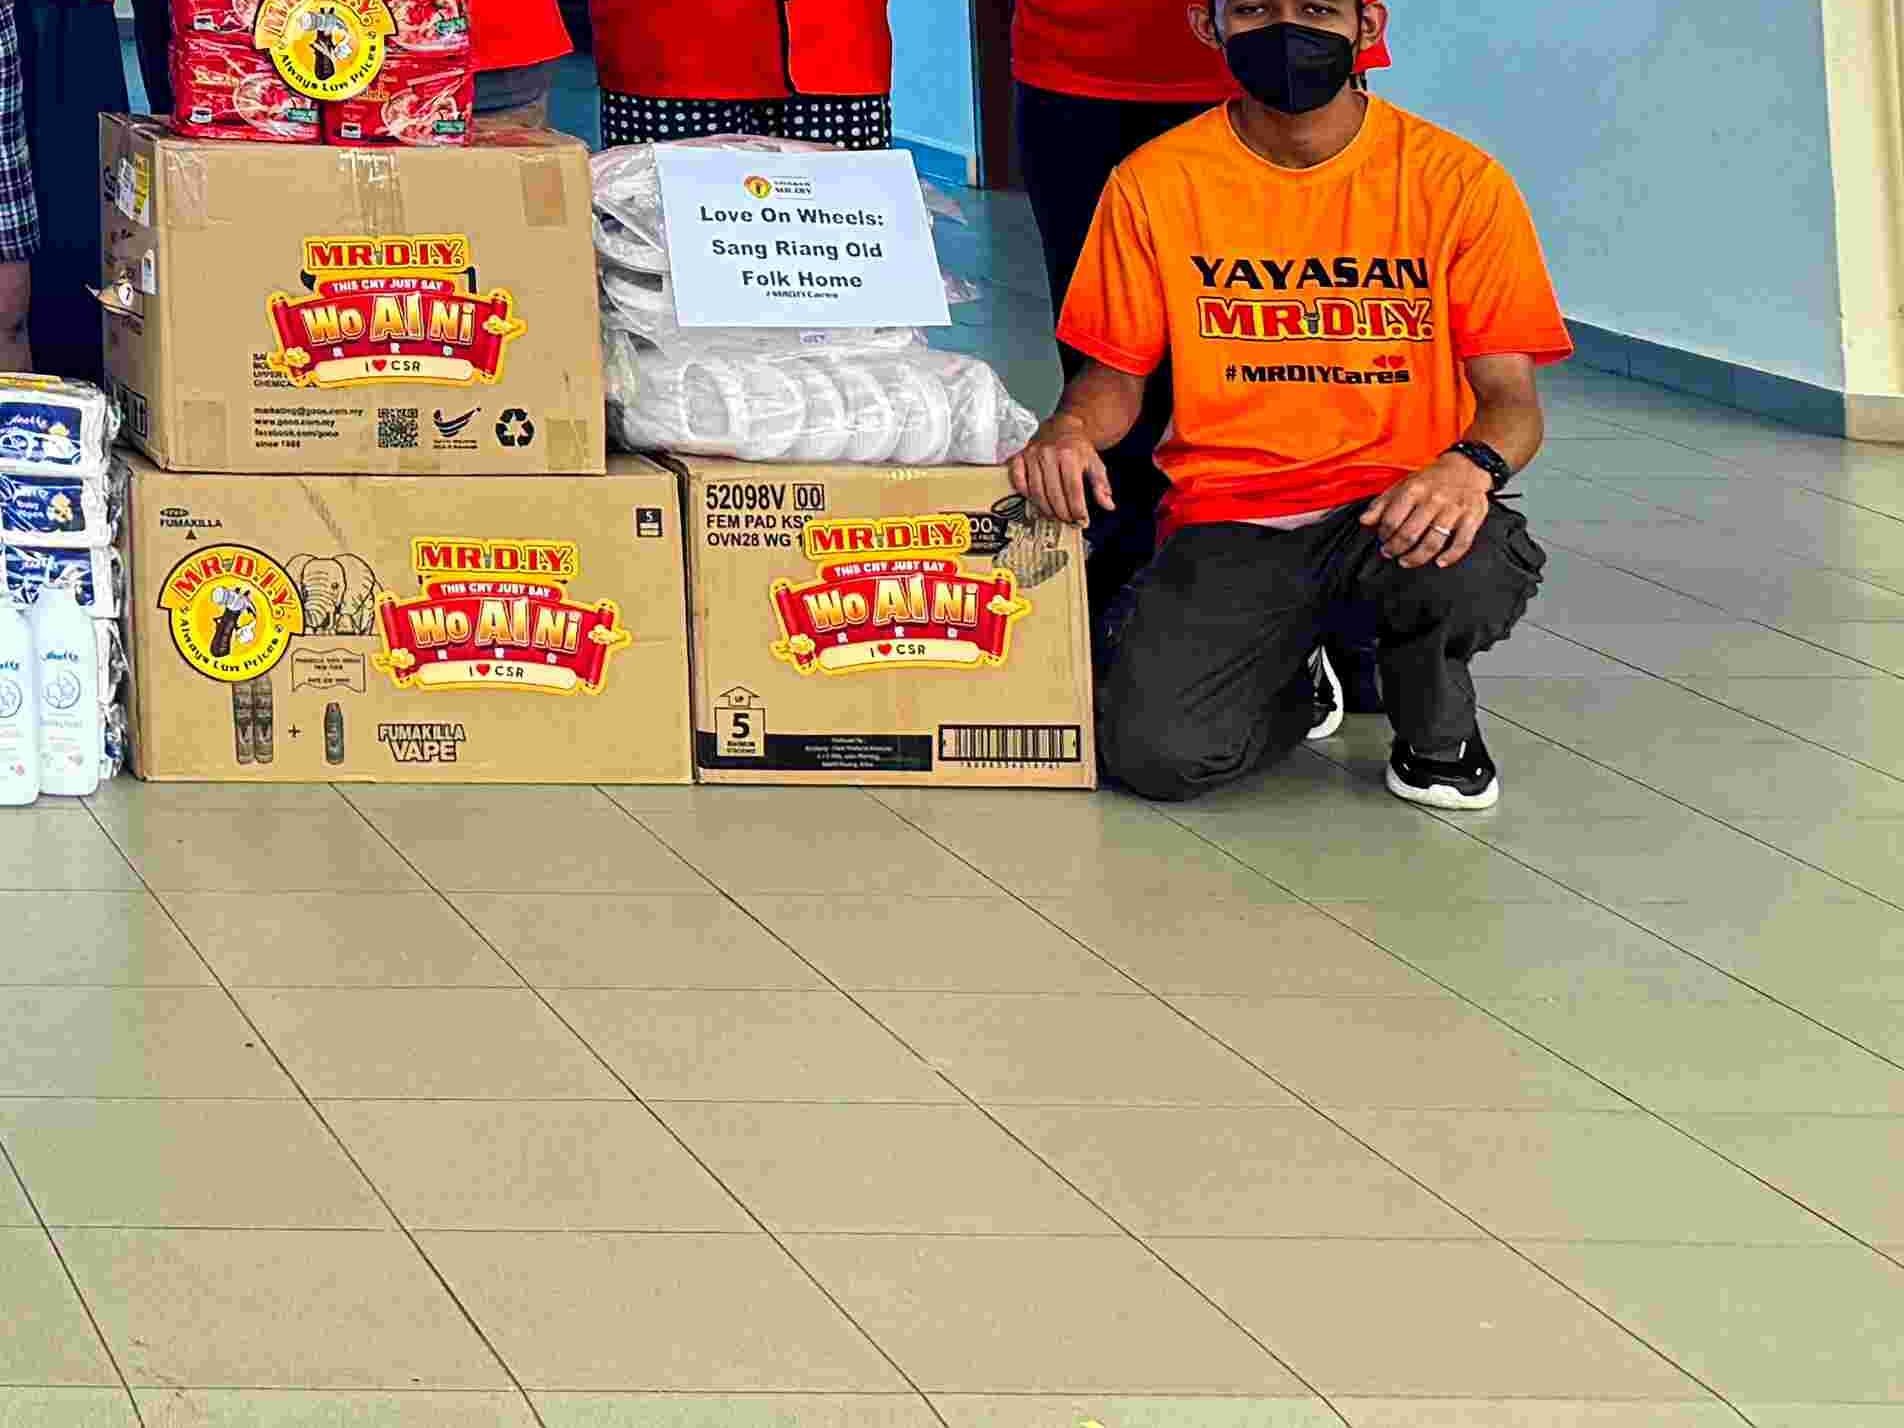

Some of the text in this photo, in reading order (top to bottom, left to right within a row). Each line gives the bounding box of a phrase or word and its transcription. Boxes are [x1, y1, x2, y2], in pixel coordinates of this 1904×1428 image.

[700, 205, 884, 228] Love On Wheels:
[711, 239, 883, 262] Sang Riang Old
[742, 270, 863, 289] Folk Home
[1190, 255, 1430, 289] YAYASAN
[301, 305, 363, 347] Wo
[430, 301, 476, 347] Ni
[705, 484, 822, 511] 52098V 00
[706, 514, 741, 530] FEM
[744, 514, 777, 530] PAD
[707, 532, 792, 547] OVN28 WG
[803, 590, 870, 632] Wo
[932, 582, 979, 625] Ni
[409, 605, 469, 649] Wo
[533, 605, 580, 650] Ni
[377, 722, 465, 744] FUMAKILLA
[731, 712, 751, 740] 5
[392, 740, 459, 763] VAPE
